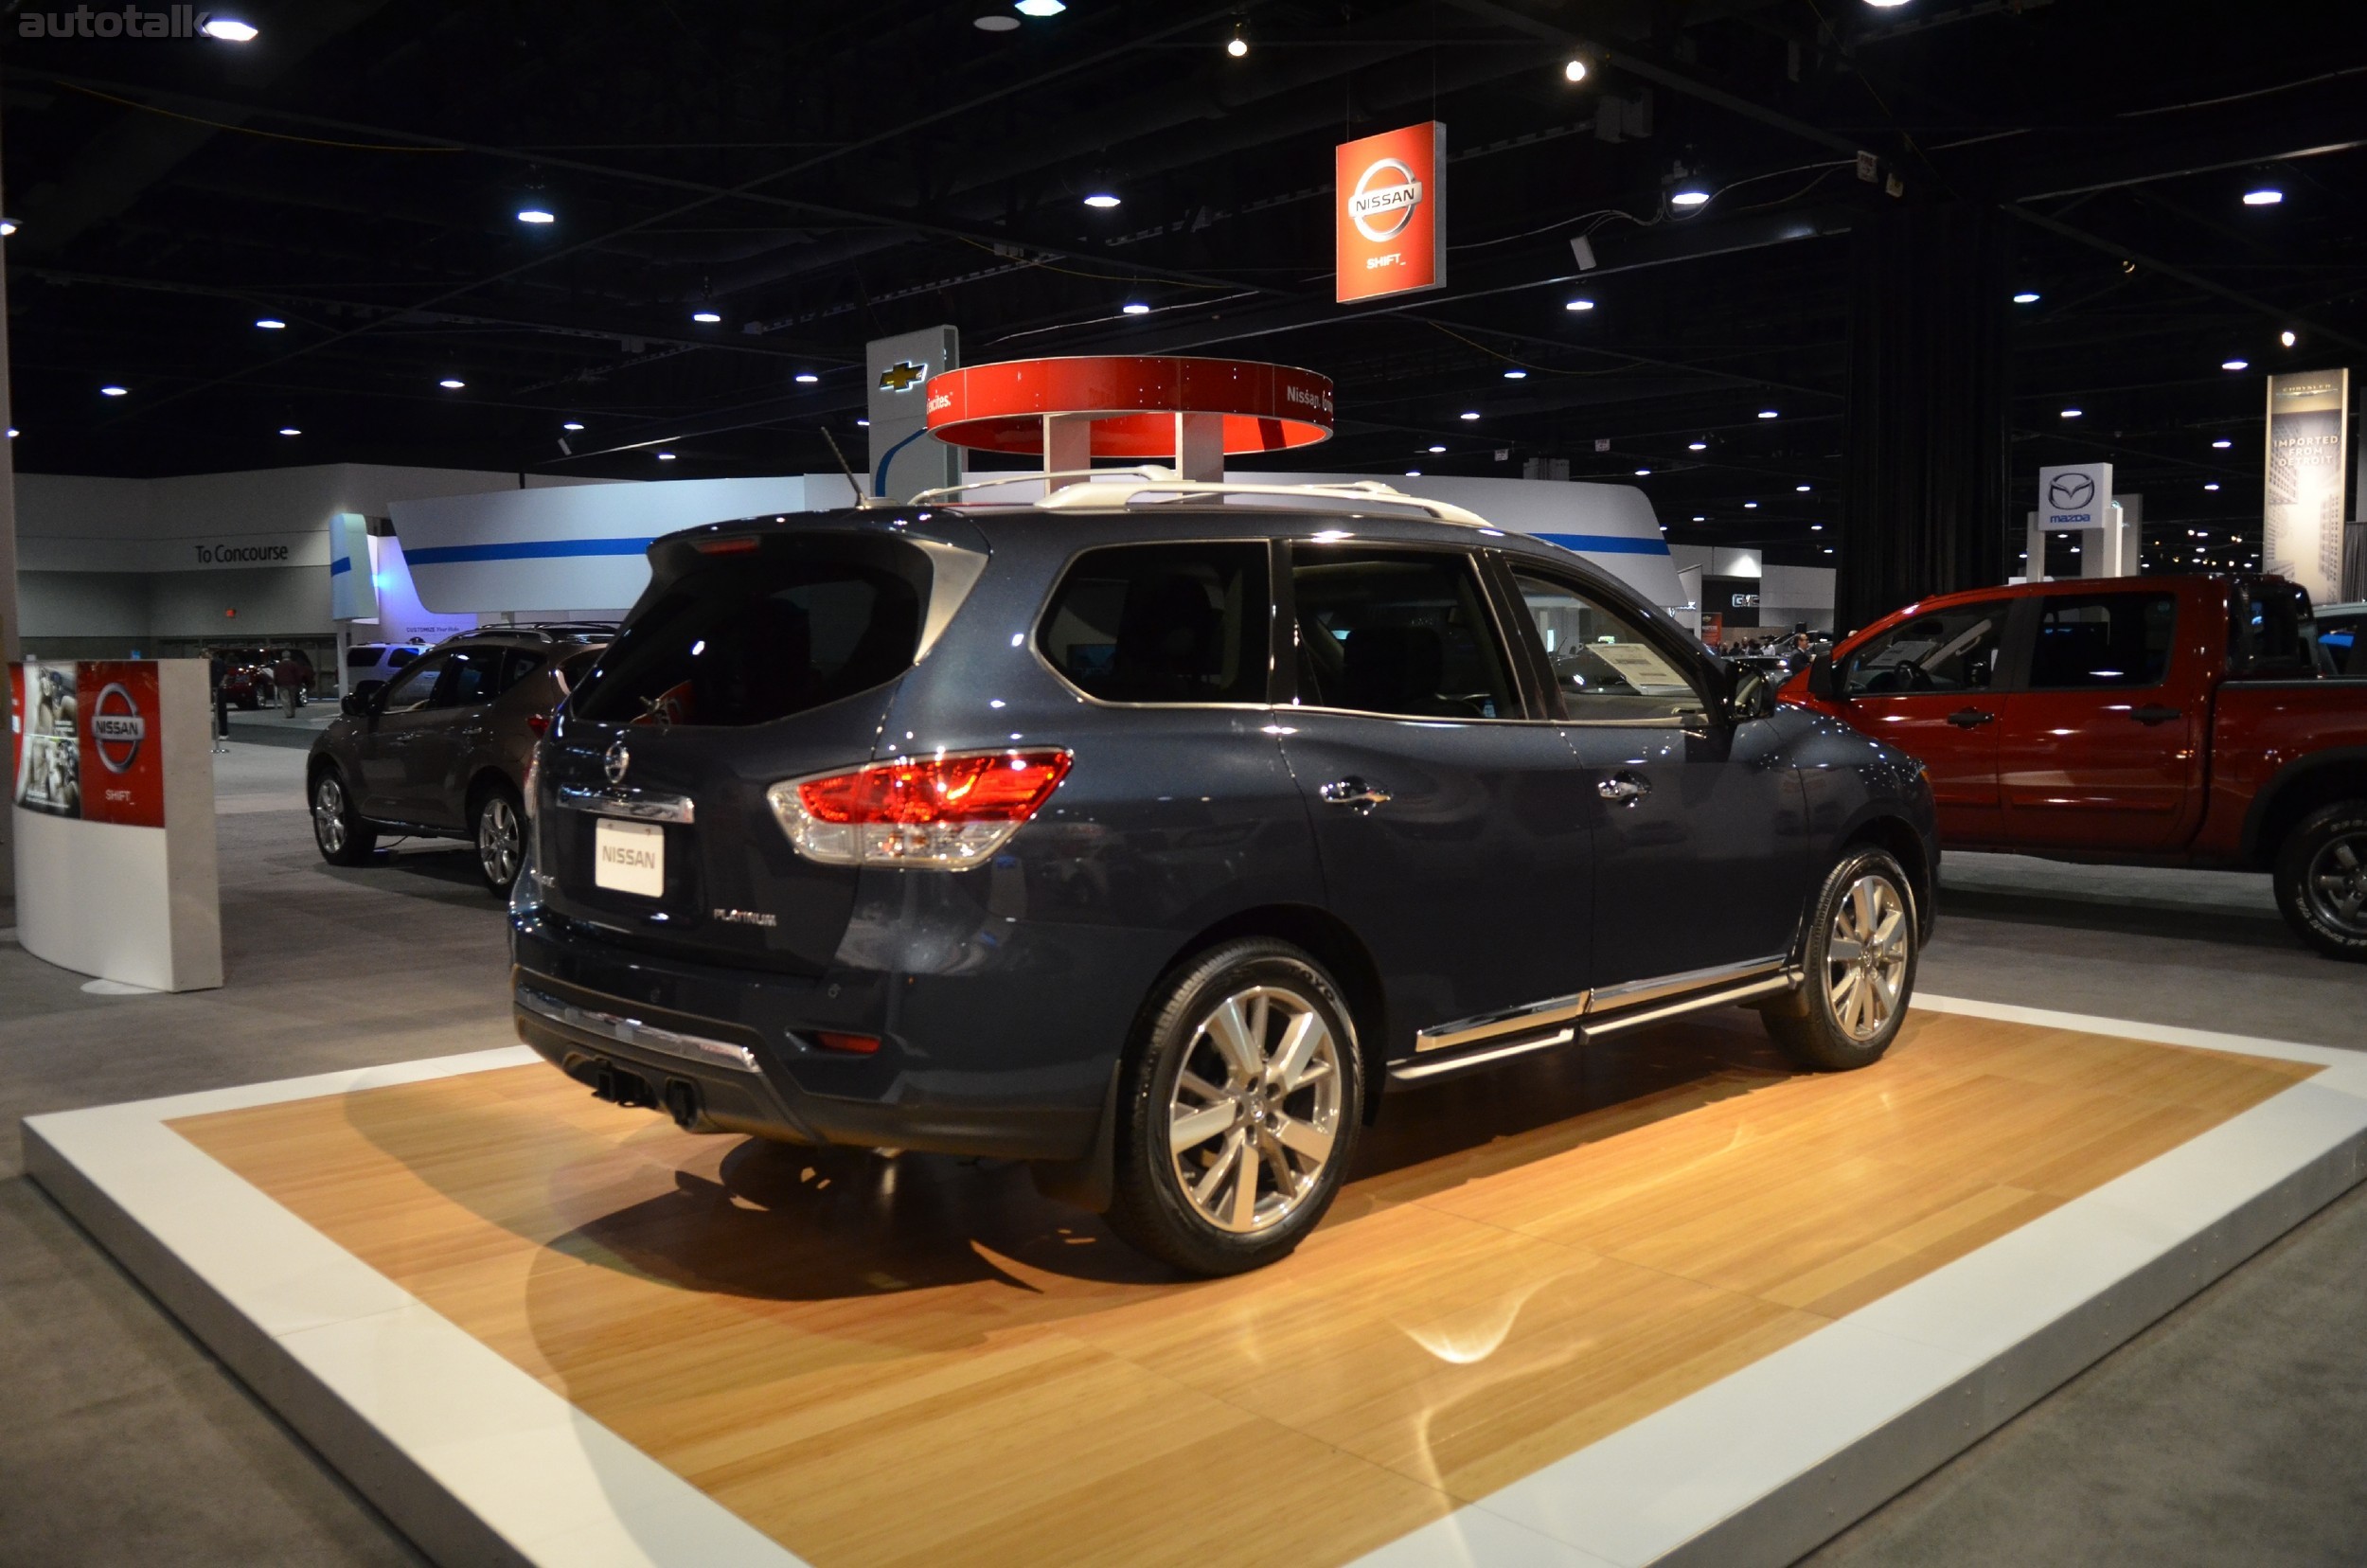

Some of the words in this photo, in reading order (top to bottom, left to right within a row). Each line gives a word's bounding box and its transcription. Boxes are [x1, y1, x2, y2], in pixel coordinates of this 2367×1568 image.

[1356, 187, 1415, 211] NISSAN
[2274, 436, 2339, 448] IMPORTED
[2288, 447, 2323, 456] FROM
[2278, 455, 2333, 467] DETROIT
[195, 545, 212, 563] To
[215, 544, 289, 562] Concourse
[96, 720, 138, 736] NISSAN
[602, 846, 655, 869] NISSAN
[713, 908, 777, 927] PLATINUM
